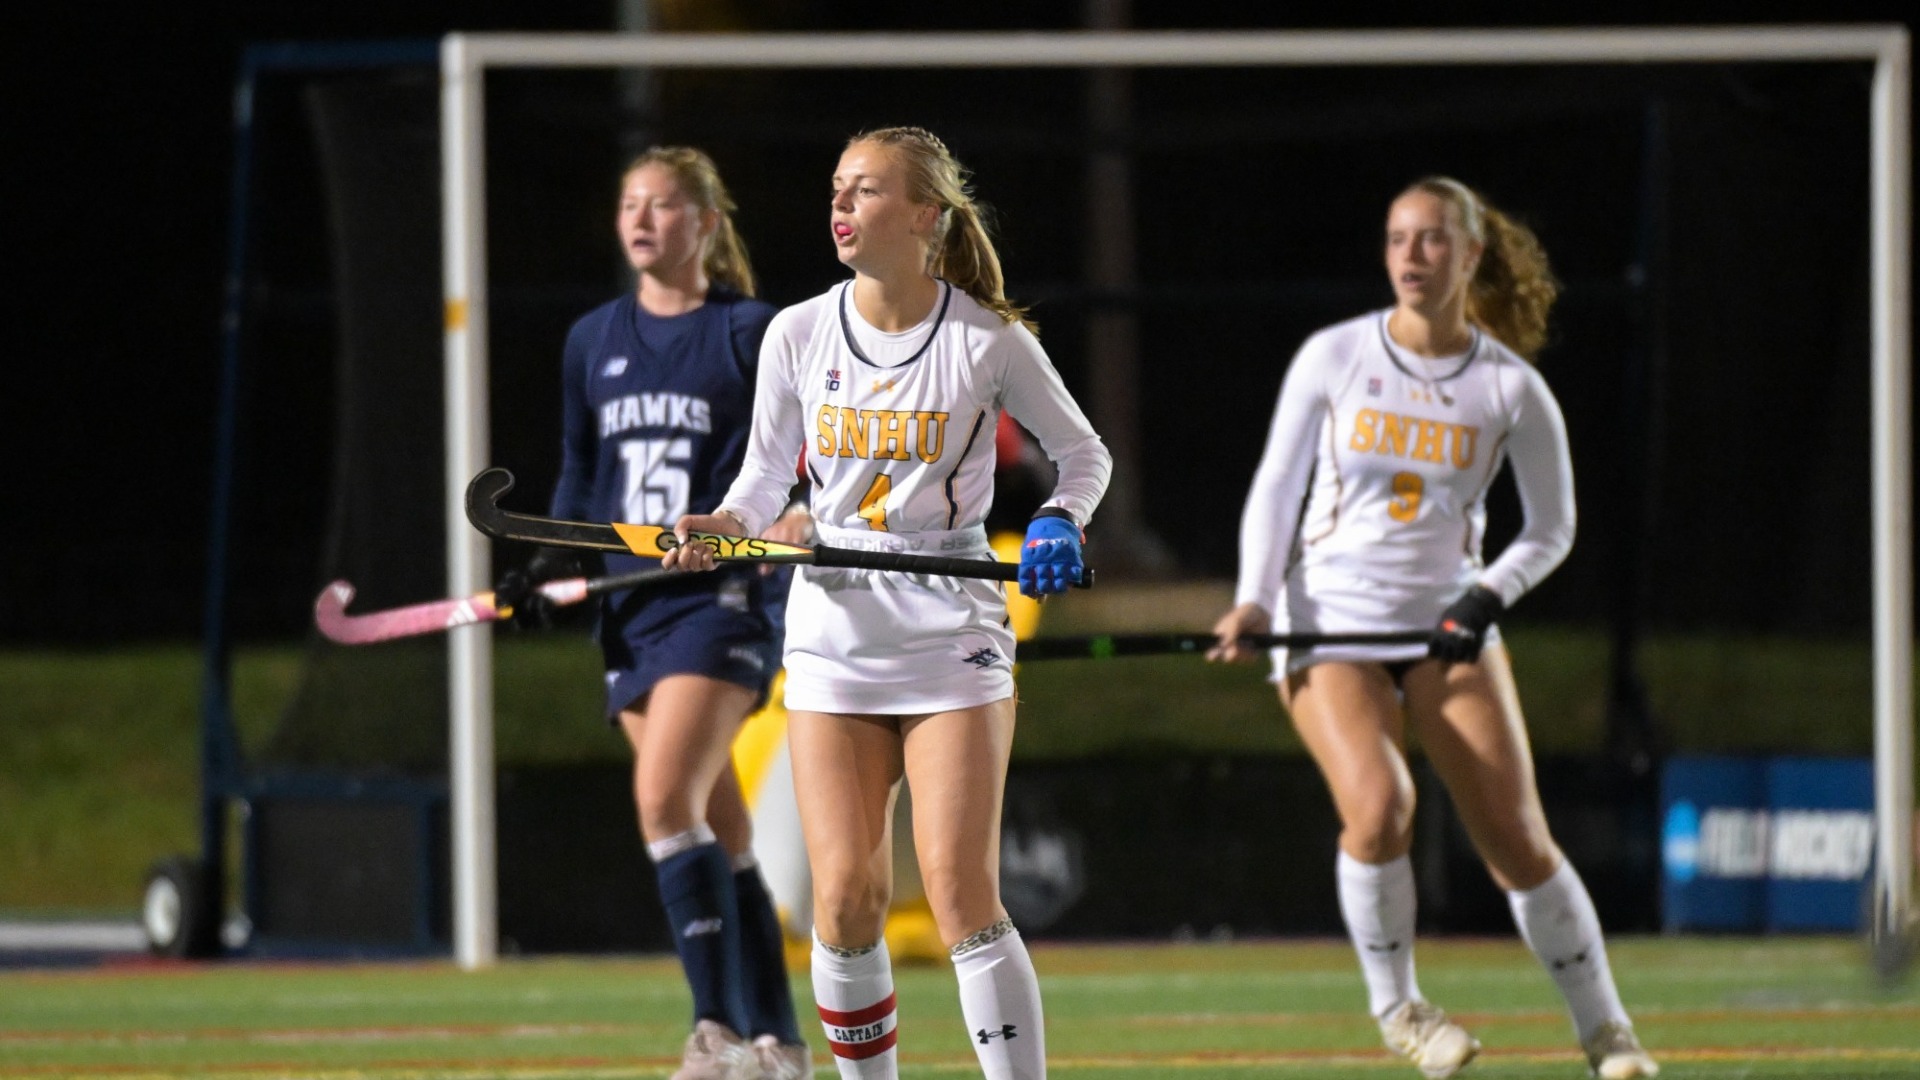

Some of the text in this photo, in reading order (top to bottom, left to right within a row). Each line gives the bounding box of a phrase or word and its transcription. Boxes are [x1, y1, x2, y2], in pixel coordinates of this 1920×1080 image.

[827, 369, 841, 379] NE
[601, 394, 711, 438] HAWKS
[816, 403, 950, 464] SNHU
[1350, 408, 1480, 470] SNHU
[618, 438, 692, 526] 15
[857, 472, 892, 532] 4
[834, 1021, 883, 1042] CAPTAIN
